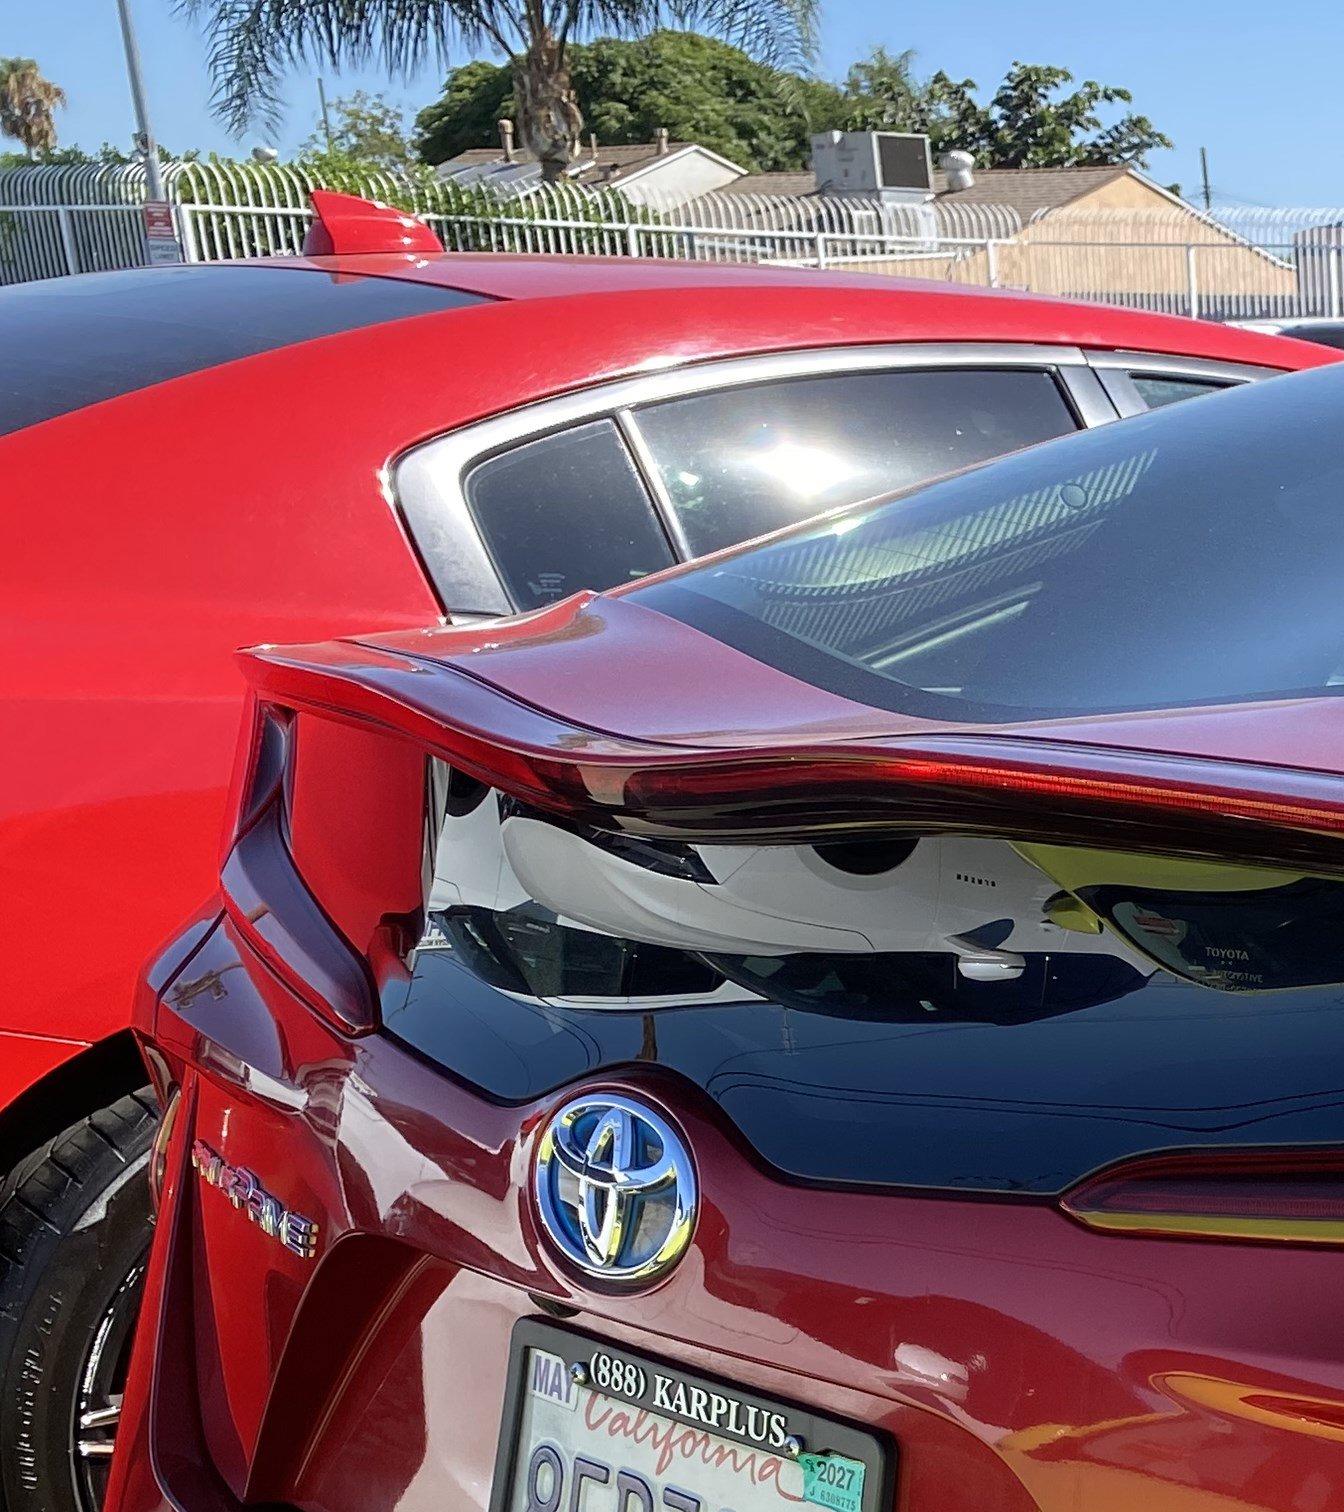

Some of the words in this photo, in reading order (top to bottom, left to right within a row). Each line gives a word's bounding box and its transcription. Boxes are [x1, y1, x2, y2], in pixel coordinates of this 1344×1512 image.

[1205, 946, 1249, 960] TOYOTA
[533, 1354, 574, 1403] MAY
[590, 1352, 646, 1400] (888)
[654, 1375, 786, 1447] KARPLUS
[585, 1393, 806, 1502] California
[816, 1460, 855, 1491] 2027
